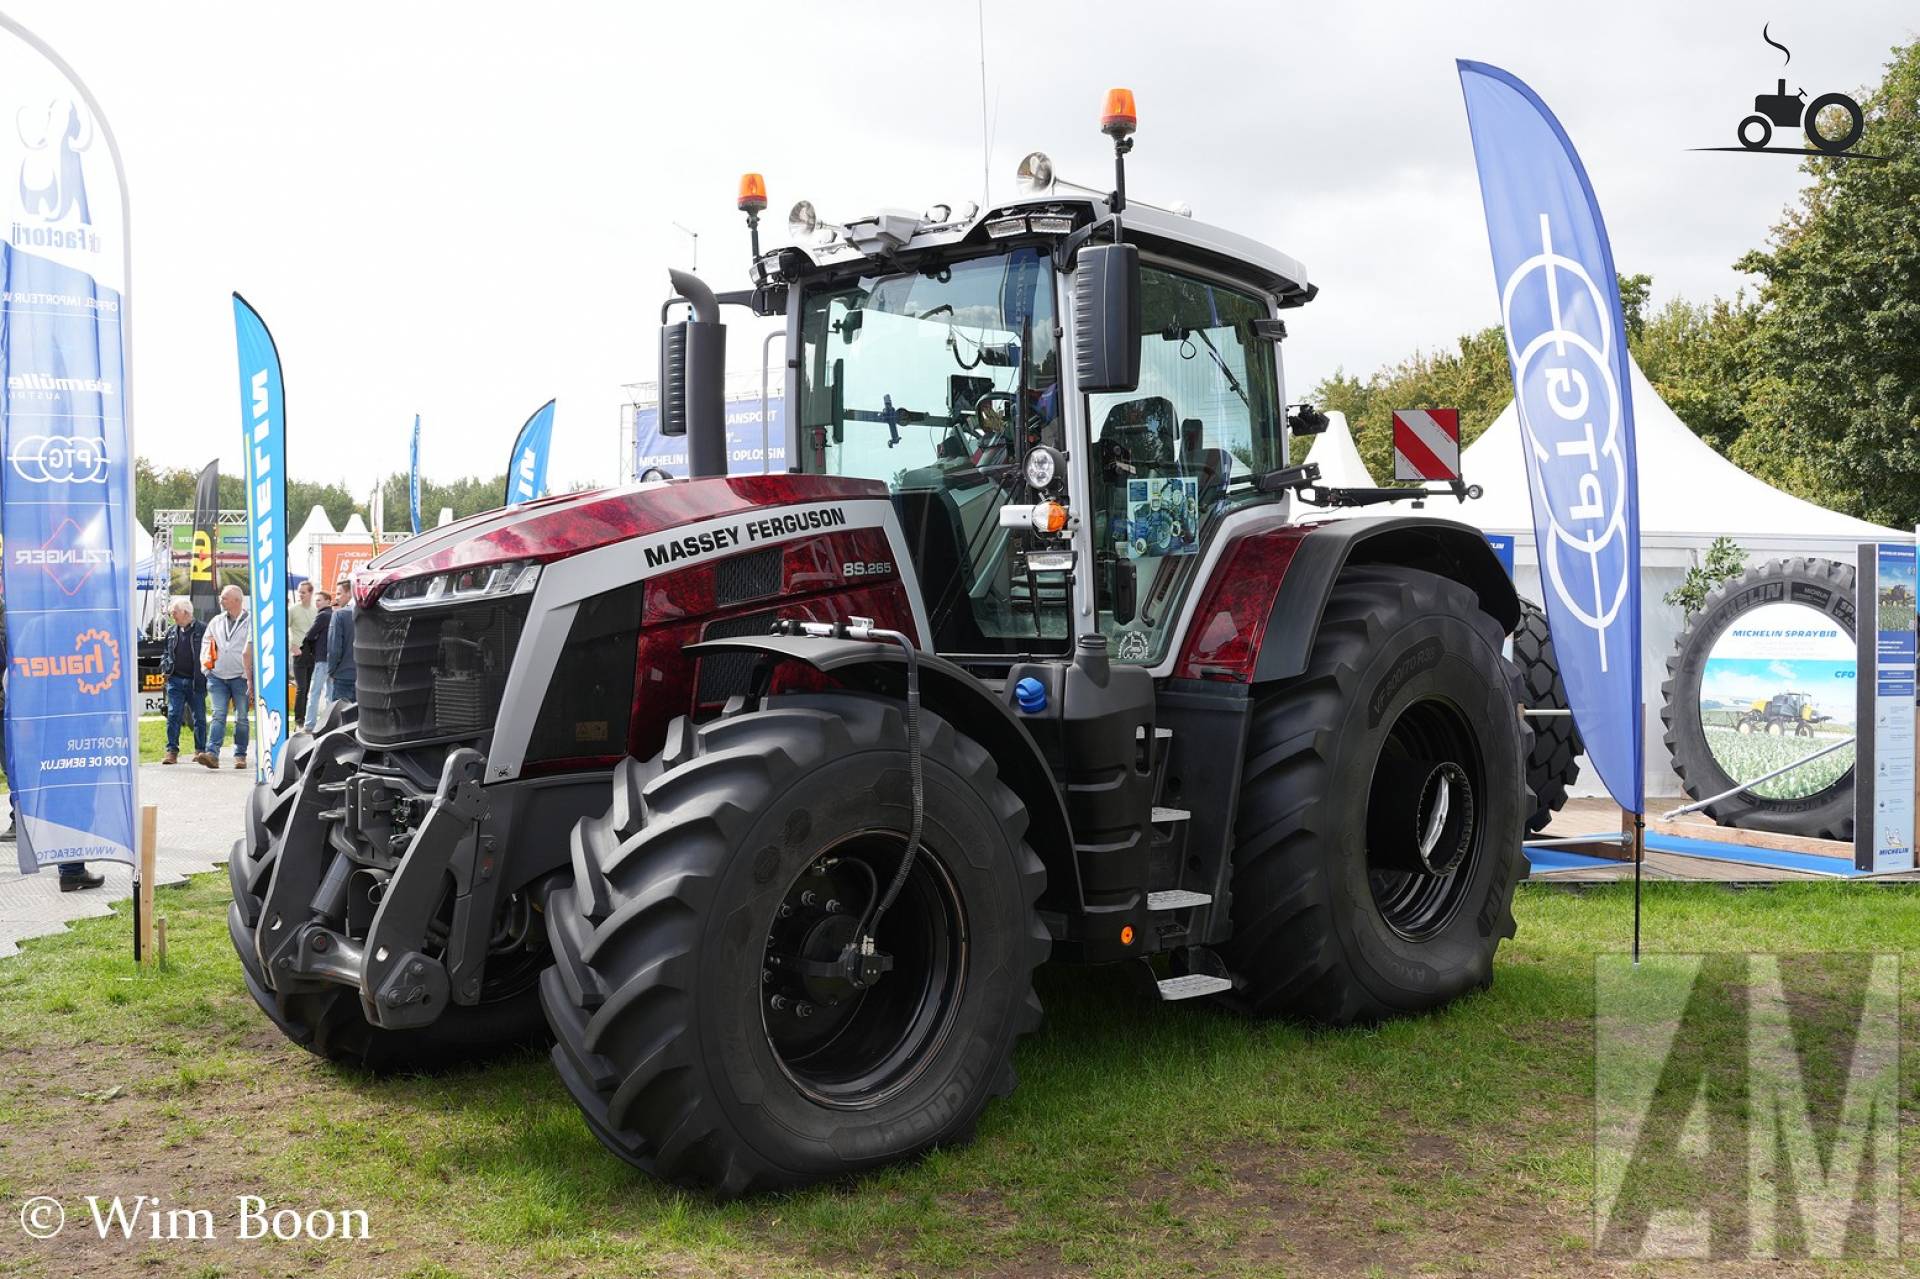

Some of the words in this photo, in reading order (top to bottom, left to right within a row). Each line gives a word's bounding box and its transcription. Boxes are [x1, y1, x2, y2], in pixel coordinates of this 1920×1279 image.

[638, 453, 684, 467] MICHELIN
[643, 525, 740, 569] MASSEY
[746, 507, 847, 542] FERGUSON
[842, 560, 892, 577] 8S.265
[1732, 630, 1783, 638] MICHELIN
[1785, 630, 1838, 638] SPRAYBIB
[1878, 846, 1909, 856] MICHELIN
